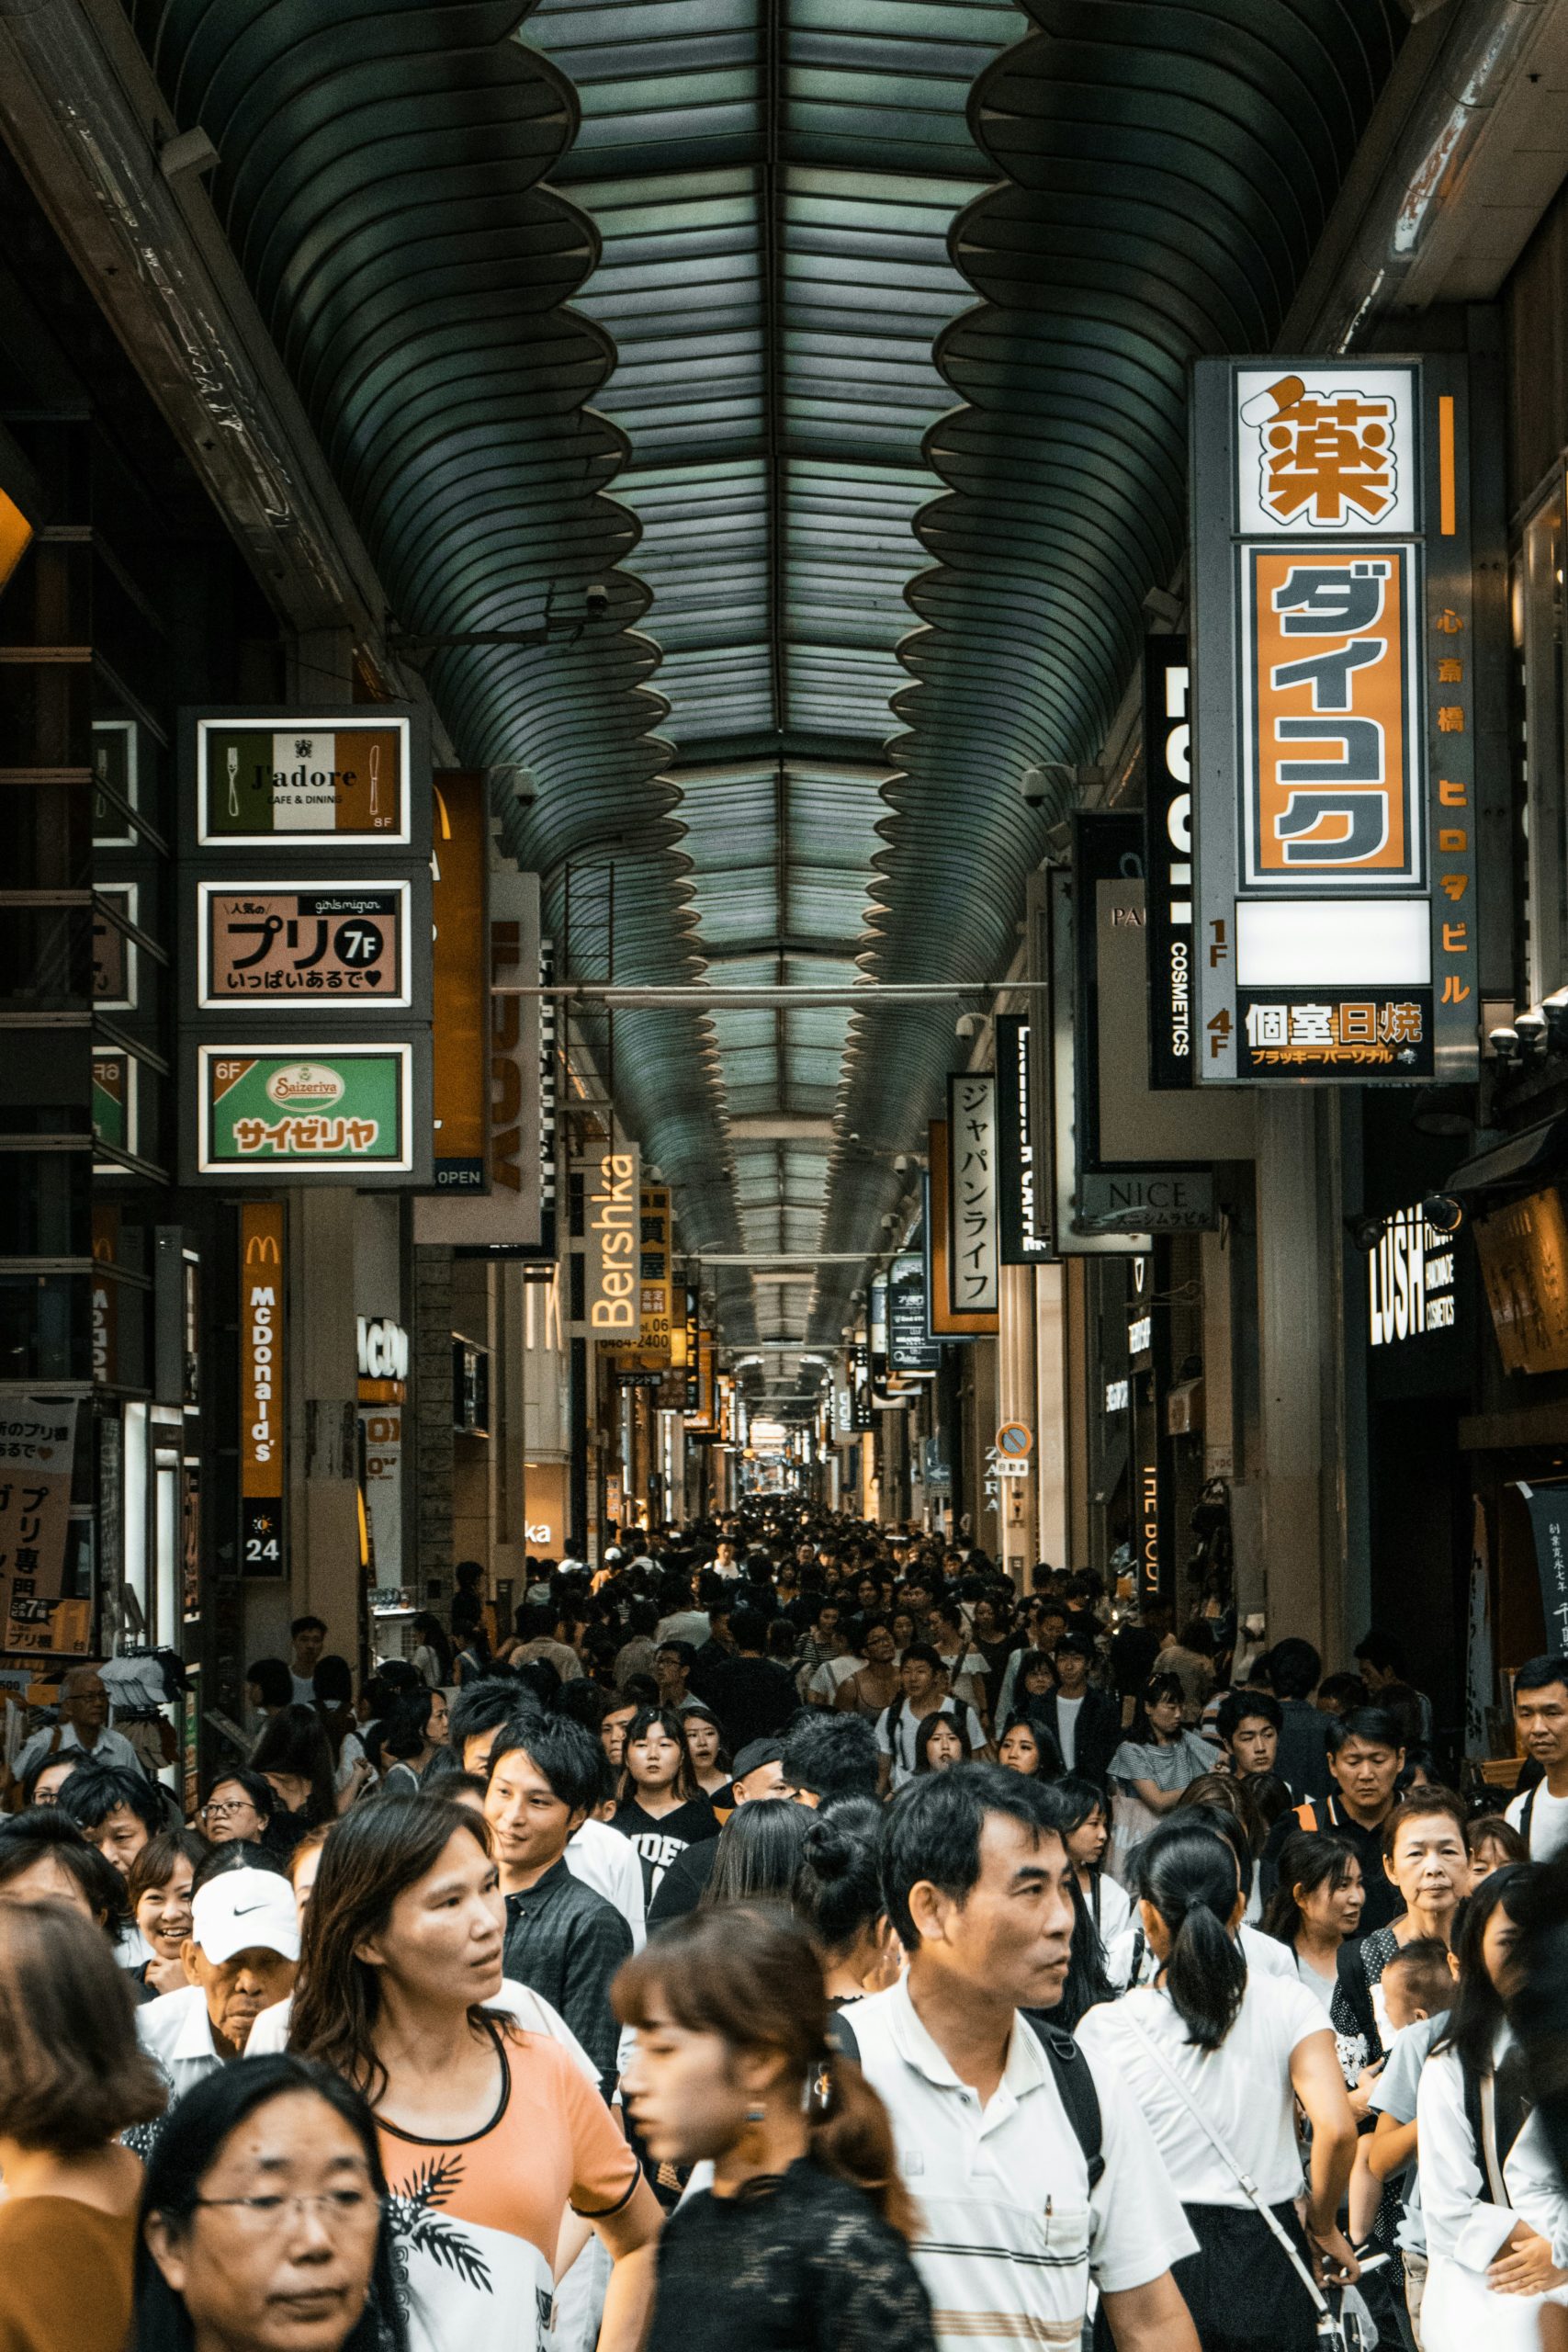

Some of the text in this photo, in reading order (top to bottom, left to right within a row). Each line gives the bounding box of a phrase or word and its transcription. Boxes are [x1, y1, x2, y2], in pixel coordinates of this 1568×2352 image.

[1267, 397, 1389, 520] 薬
[1270, 560, 1391, 865] ダイコク
[251, 764, 358, 790] J'adore
[267, 795, 344, 805] CAFE & DINING
[374, 817, 392, 827] 8F
[1438, 779, 1470, 1004] ヒロタビル
[1111, 908, 1146, 927] PA
[227, 914, 376, 970] プリ 7F
[227, 969, 363, 989] いっぱいあるで
[1170, 942, 1190, 1057] COSMETICS
[1245, 1002, 1423, 1046] 個室日焼
[216, 1062, 241, 1080] 6F
[273, 1078, 337, 1099] Saizeriya
[235, 1117, 376, 1150] サイゼリヤ
[437, 1171, 480, 1184] OPEN
[960, 1083, 989, 1302] ジャパンライフ
[1109, 1182, 1189, 1207] NICE
[591, 1154, 635, 1329] Bershka
[1369, 1203, 1425, 1346] LUSH
[652, 1318, 669, 1332] 06
[250, 1286, 276, 1463] McDonald's
[983, 1446, 999, 1512] ZARA
[246, 1539, 279, 1560] 24
